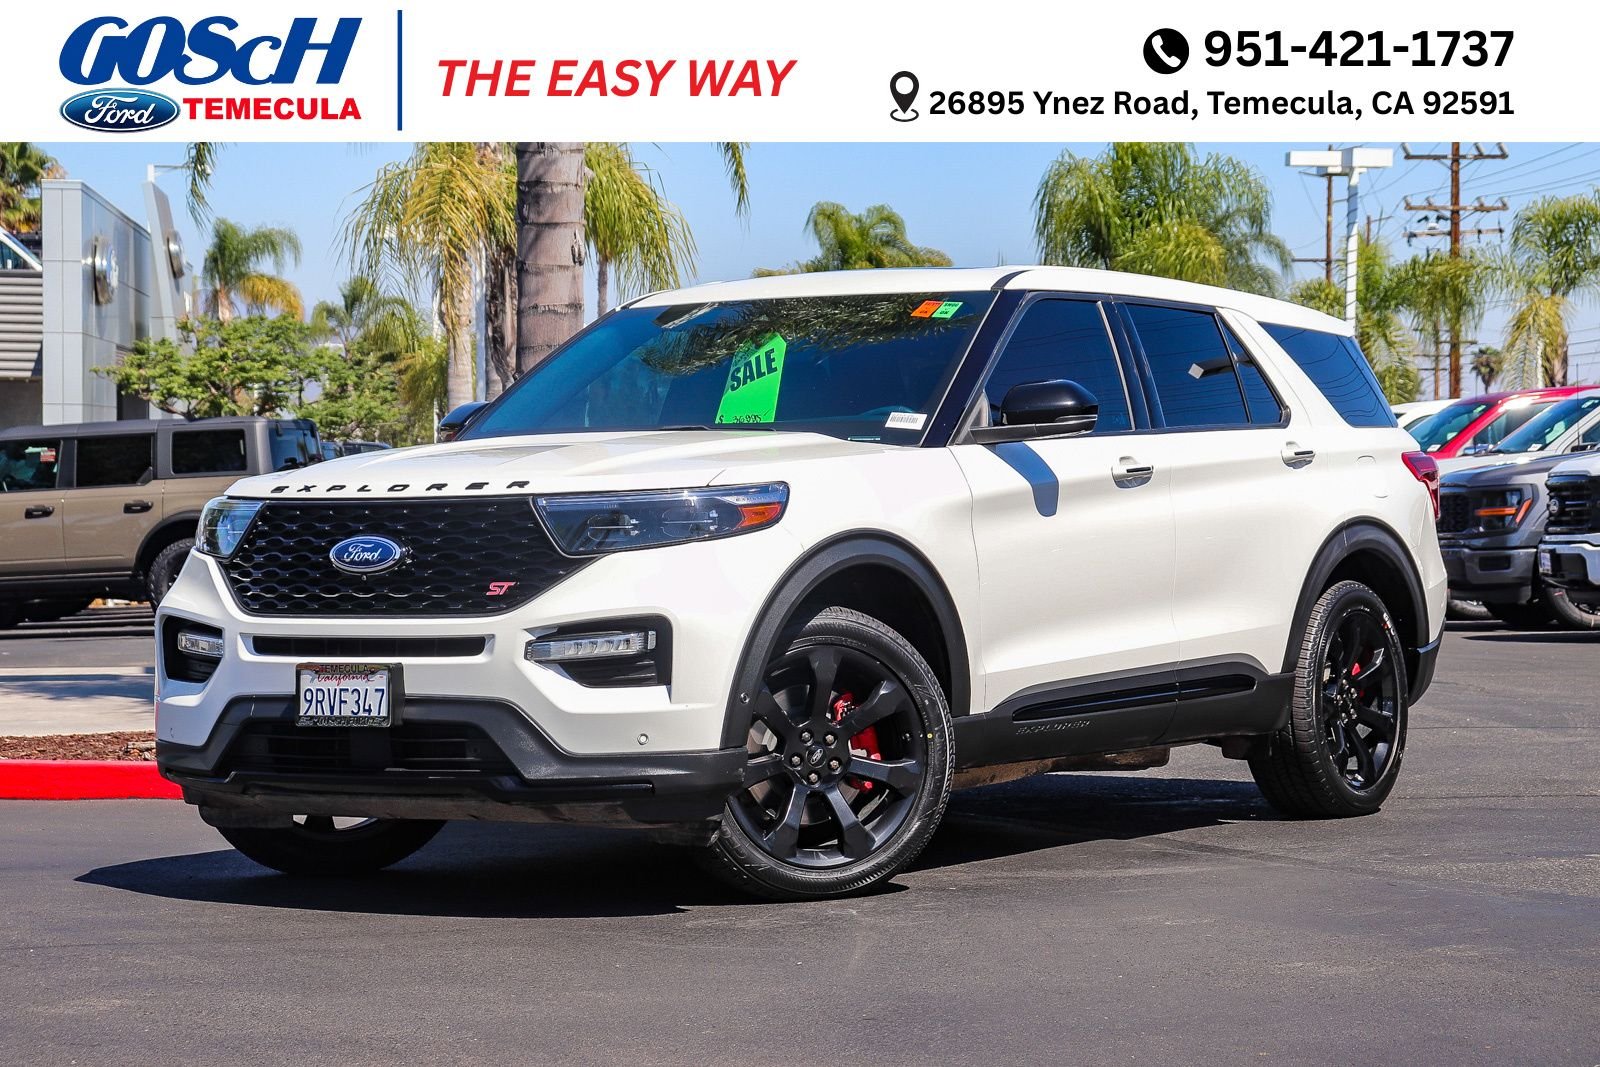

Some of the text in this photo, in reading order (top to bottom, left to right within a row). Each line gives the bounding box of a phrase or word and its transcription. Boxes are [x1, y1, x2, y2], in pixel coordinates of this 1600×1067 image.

[729, 347, 778, 392] SALE
[270, 481, 530, 494] EXPLORER
[343, 543, 382, 562] Ford
[486, 581, 516, 596] ST
[319, 664, 369, 674] TEMECULA
[303, 687, 385, 716] 9RVF347
